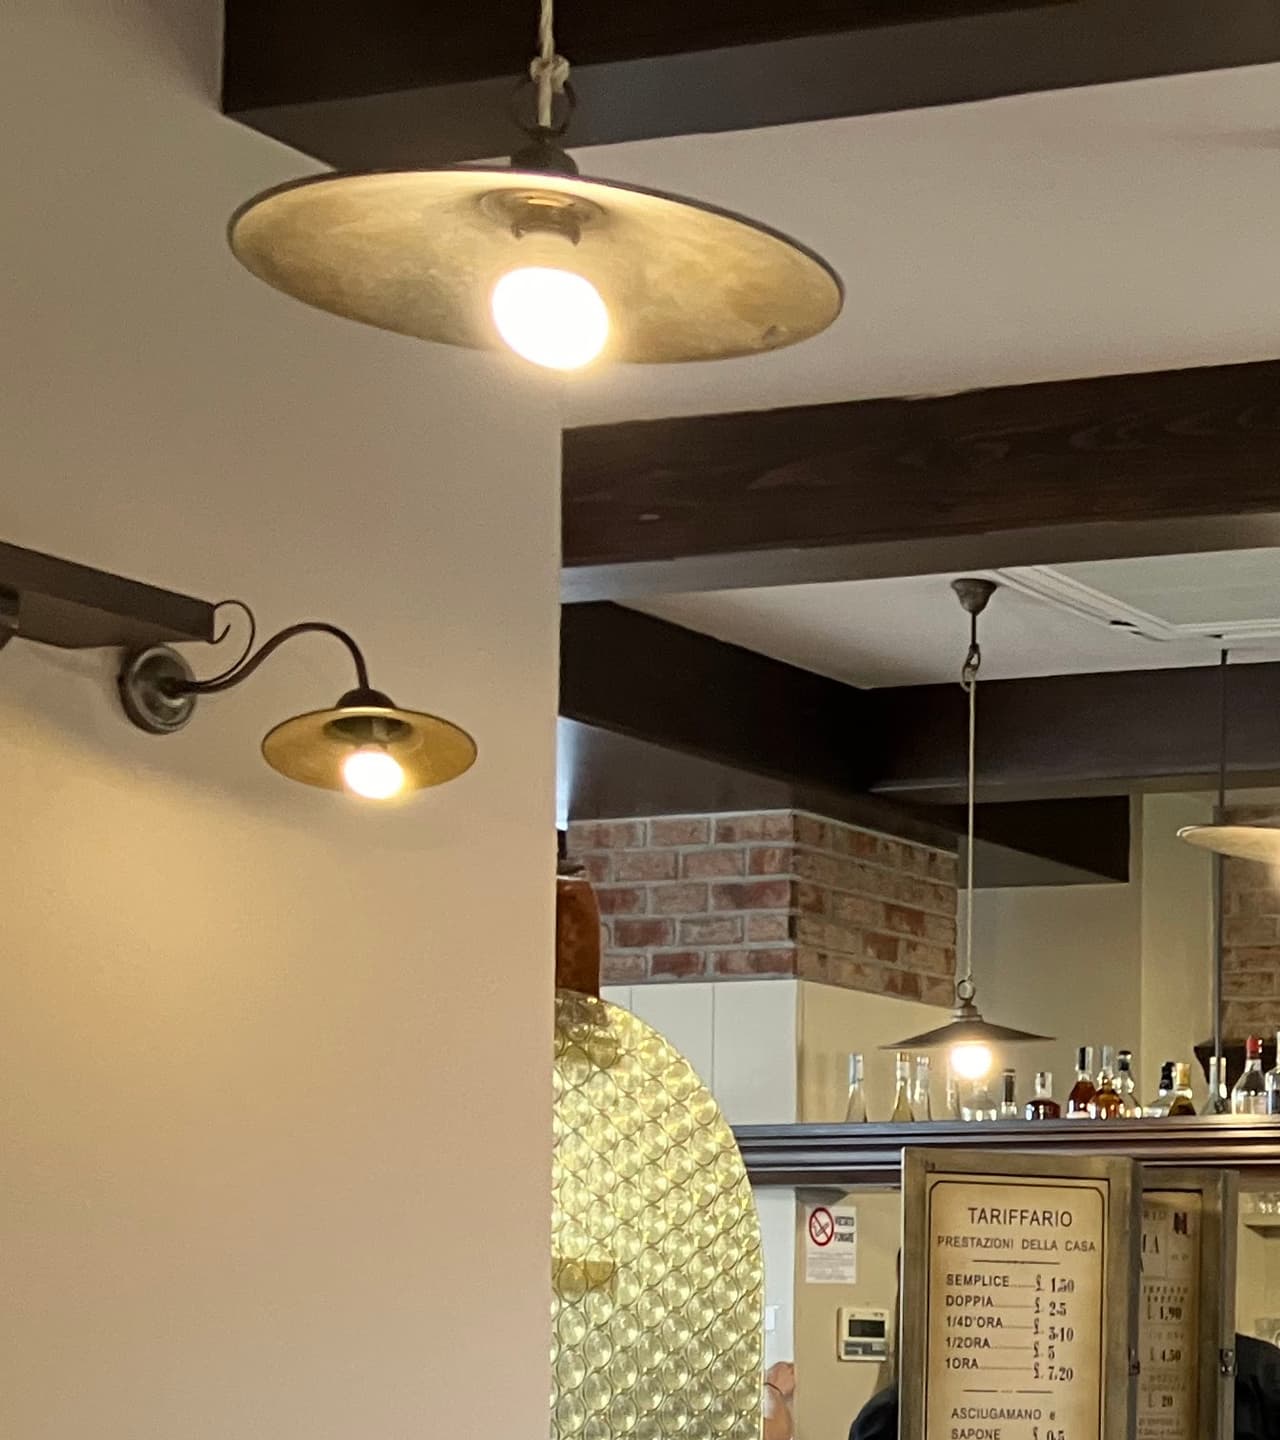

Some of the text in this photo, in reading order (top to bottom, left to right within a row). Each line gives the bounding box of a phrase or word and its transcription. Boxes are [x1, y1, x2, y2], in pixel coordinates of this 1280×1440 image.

[967, 1207, 1073, 1228] TARIFFARIO
[937, 1235, 1096, 1252] PRESTAZIONI DELLA CASA
[946, 1273, 1010, 1288] SEMPLICE
[945, 1295, 993, 1307] DOPPIA
[946, 1336, 991, 1349] 1/2ORA
[1048, 1345, 1055, 1360] 5
[951, 1407, 1056, 1421] ASCIUGAMANO e
[951, 1428, 1001, 1440] SAPONE
